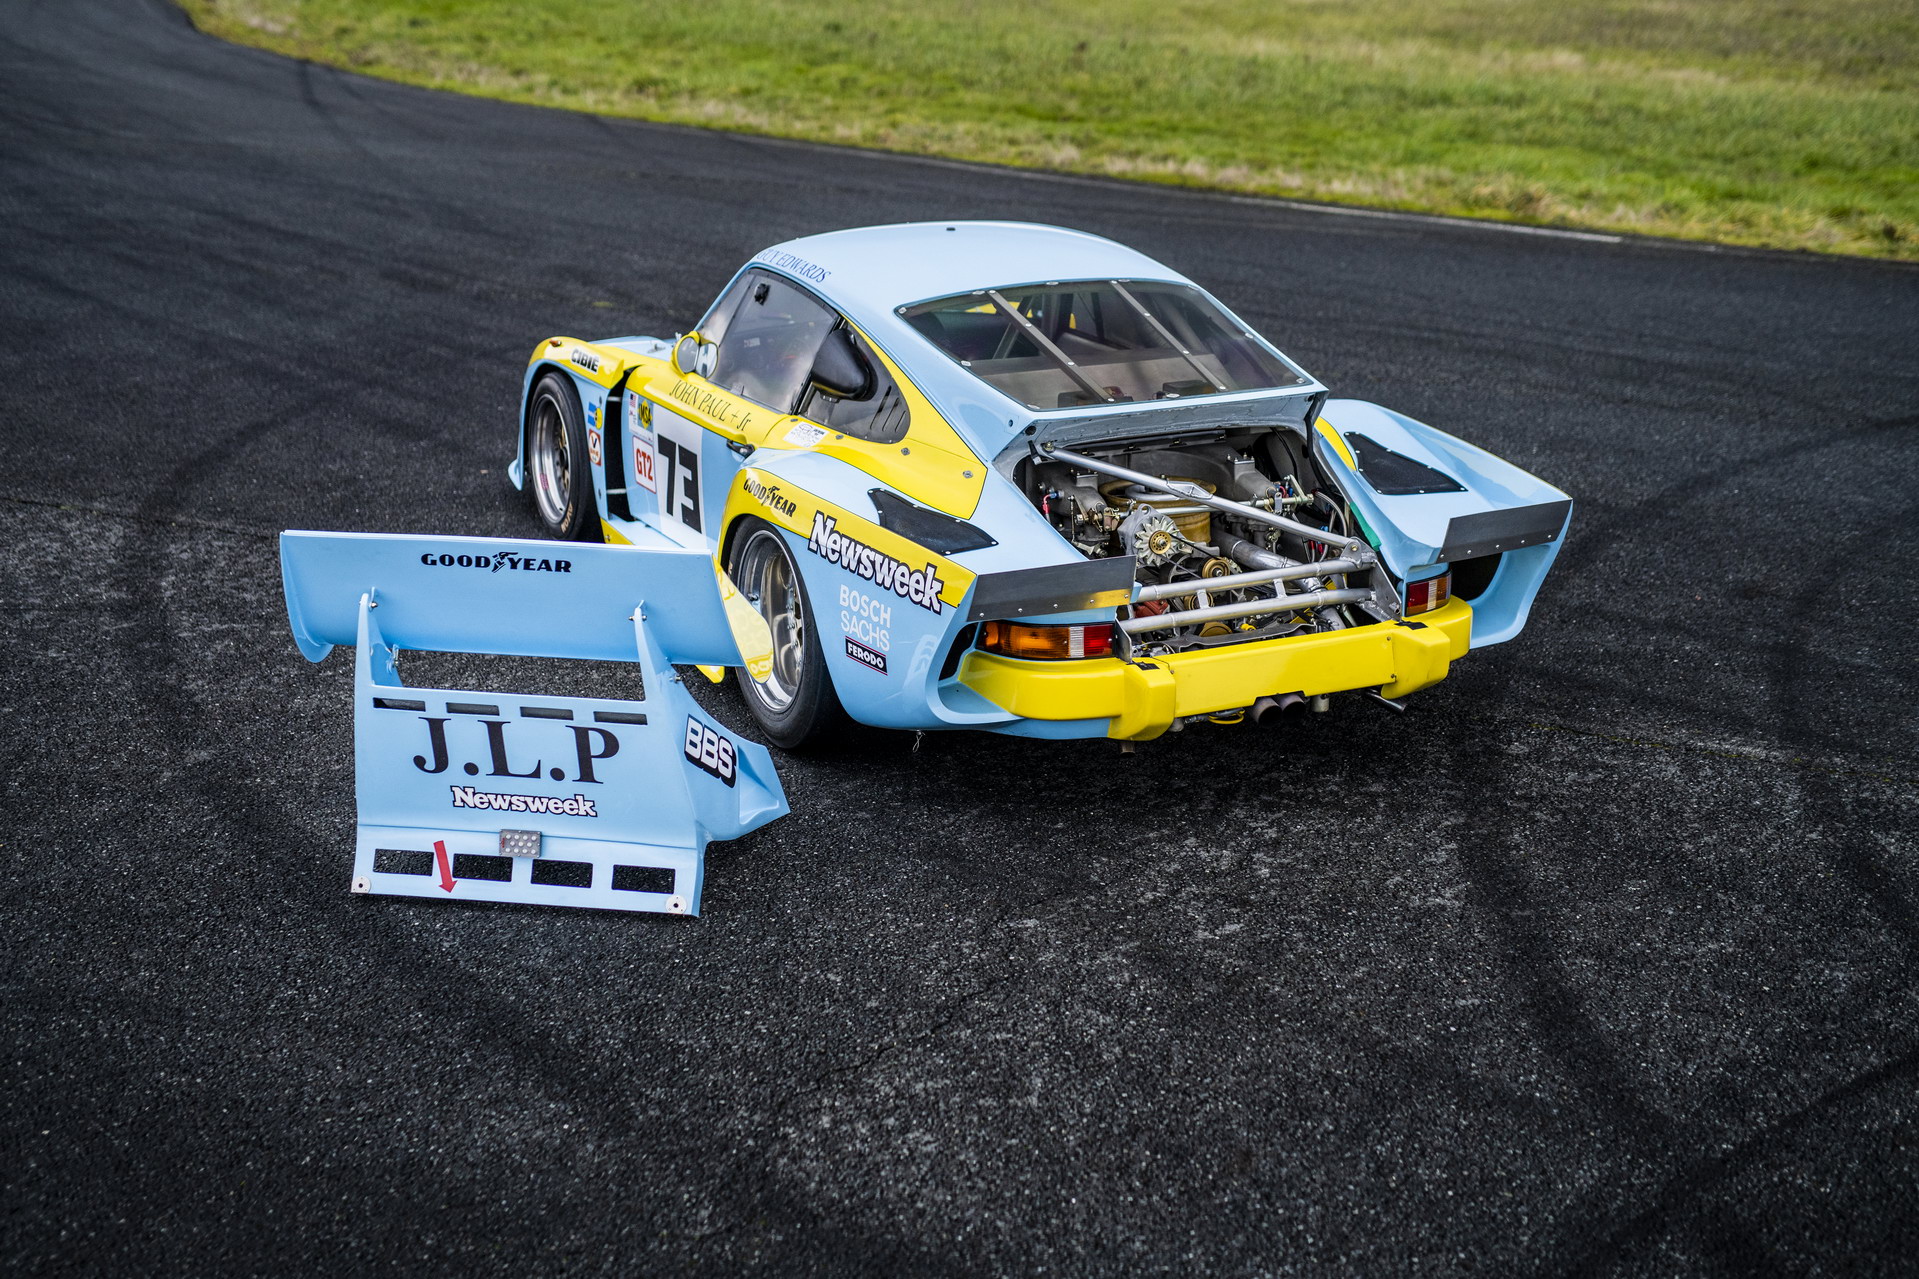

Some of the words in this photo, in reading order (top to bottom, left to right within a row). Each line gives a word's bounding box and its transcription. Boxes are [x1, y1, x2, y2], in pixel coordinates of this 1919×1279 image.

[776, 253, 831, 283] EDWARDS
[669, 379, 704, 406] JOHN
[698, 393, 731, 422] PAUL
[736, 412, 752, 431] Jr
[636, 448, 653, 481] GT2
[657, 432, 703, 535] 73
[808, 510, 944, 615] Newsweek
[839, 584, 892, 628] BOSCH
[840, 610, 890, 652] SACHS
[847, 644, 884, 669] FERODO
[413, 716, 620, 785] J.L.P
[684, 714, 736, 788] BBS
[450, 785, 597, 817] Newsweek
